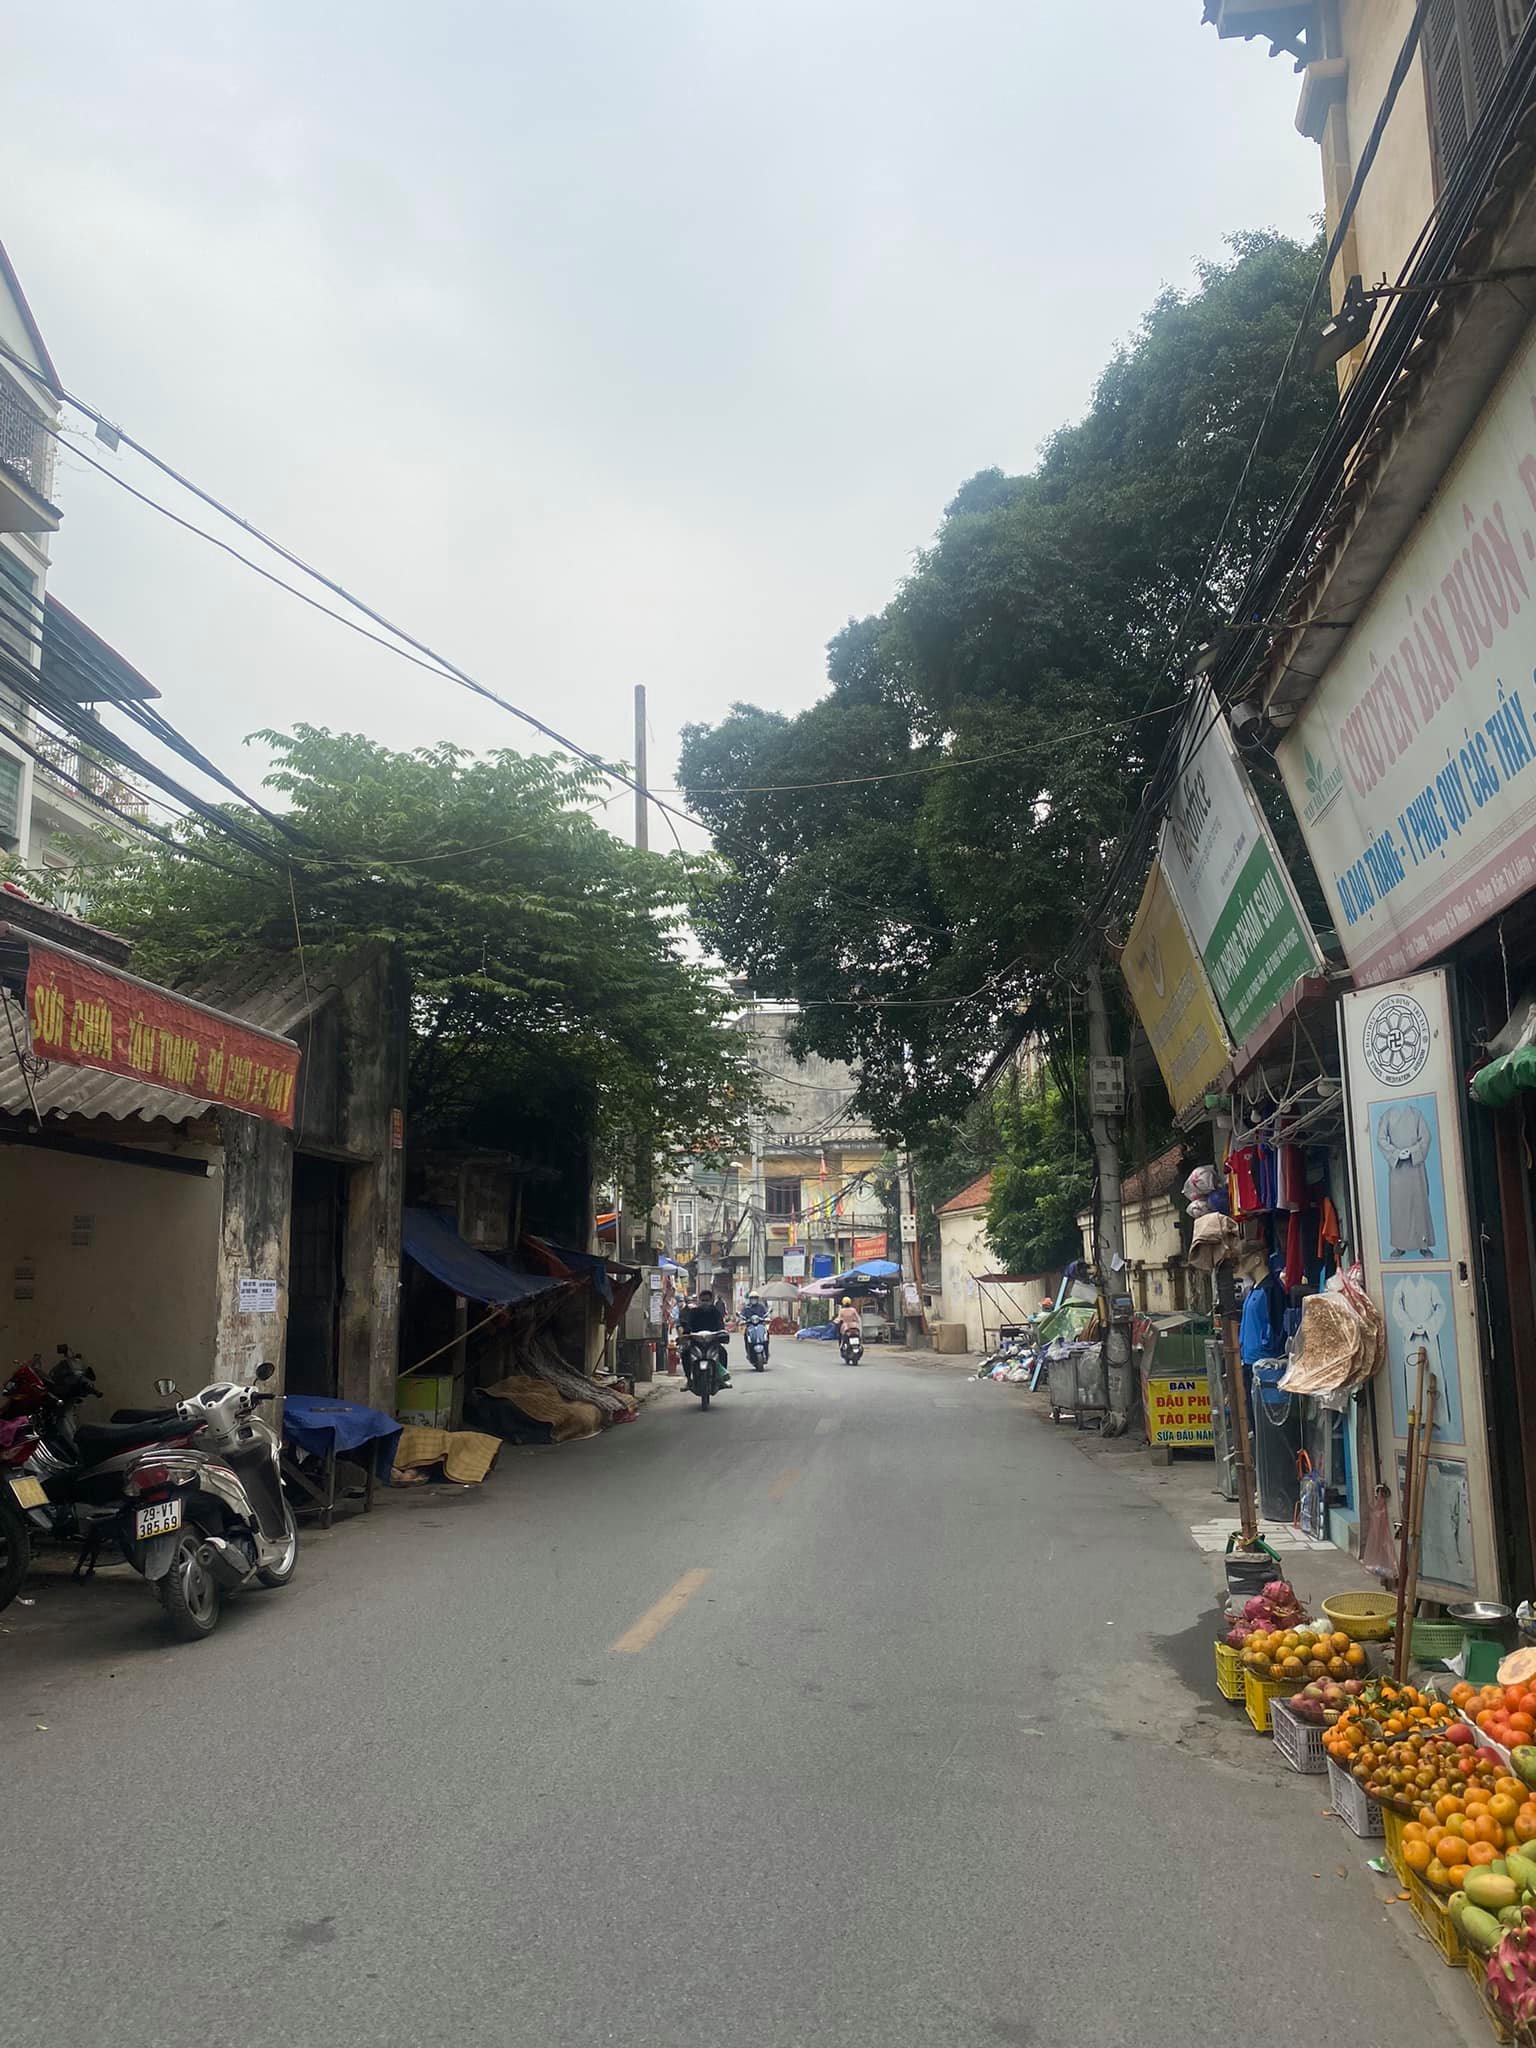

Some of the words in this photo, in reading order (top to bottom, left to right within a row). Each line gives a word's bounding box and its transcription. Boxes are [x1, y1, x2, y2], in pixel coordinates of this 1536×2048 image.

[1340, 650, 1420, 800] CHUYÊN
[1399, 594, 1463, 725] BÁN
[1440, 501, 1530, 670] BUÔN
[1436, 747, 1473, 836] QUÝ
[1459, 727, 1500, 808] CÁC
[1398, 813, 1419, 867] Y
[1406, 785, 1449, 860] PHỤC
[1236, 893, 1265, 957] PHẨM
[1253, 868, 1285, 929] SUMI
[1334, 872, 1358, 927] ÁO
[1346, 859, 1376, 922] ĐẠO
[31, 971, 64, 1047] SỬA
[70, 996, 113, 1061] CHỮA
[128, 1010, 156, 1073] TÂN
[159, 1032, 199, 1088] TRANG
[224, 1053, 252, 1102] CHƠI
[250, 1063, 268, 1104] XE
[267, 1064, 294, 1113] MÁY
[1156, 1395, 1184, 1410] ĐẬU
[1158, 1412, 1184, 1425] TÀO
[139, 1515, 178, 1538] 385.69
[143, 1502, 174, 1523] 29-V1
